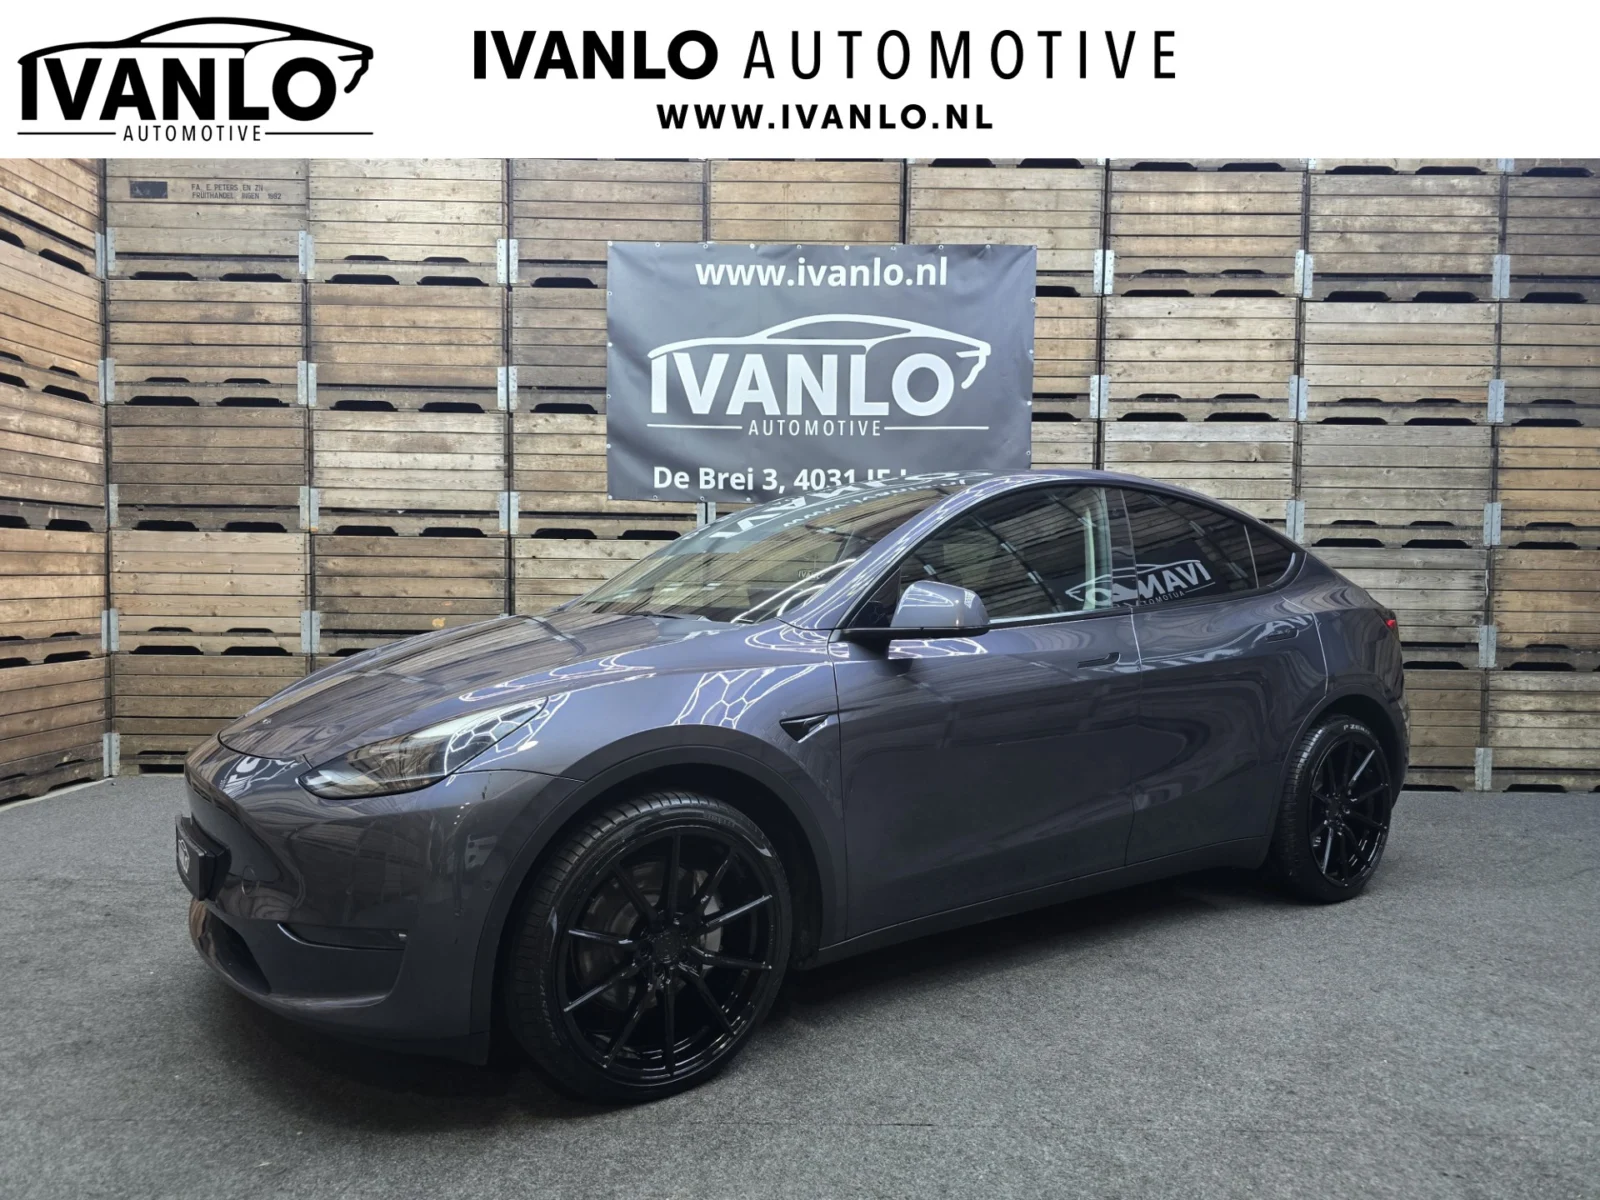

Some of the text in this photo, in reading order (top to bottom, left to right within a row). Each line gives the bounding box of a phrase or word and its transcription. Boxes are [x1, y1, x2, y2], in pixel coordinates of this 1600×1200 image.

[191, 191, 234, 200] FRUITHANDEL
[214, 184, 239, 192] PETERS
[242, 184, 252, 192] EN
[694, 256, 948, 287] www.ivanlo.nl
[650, 351, 955, 417] IVANLO
[748, 419, 881, 437] AUTOMOTIVE
[653, 466, 690, 490] De
[699, 466, 754, 491] Brei
[762, 468, 786, 494] 3,
[793, 468, 856, 491] 4031
